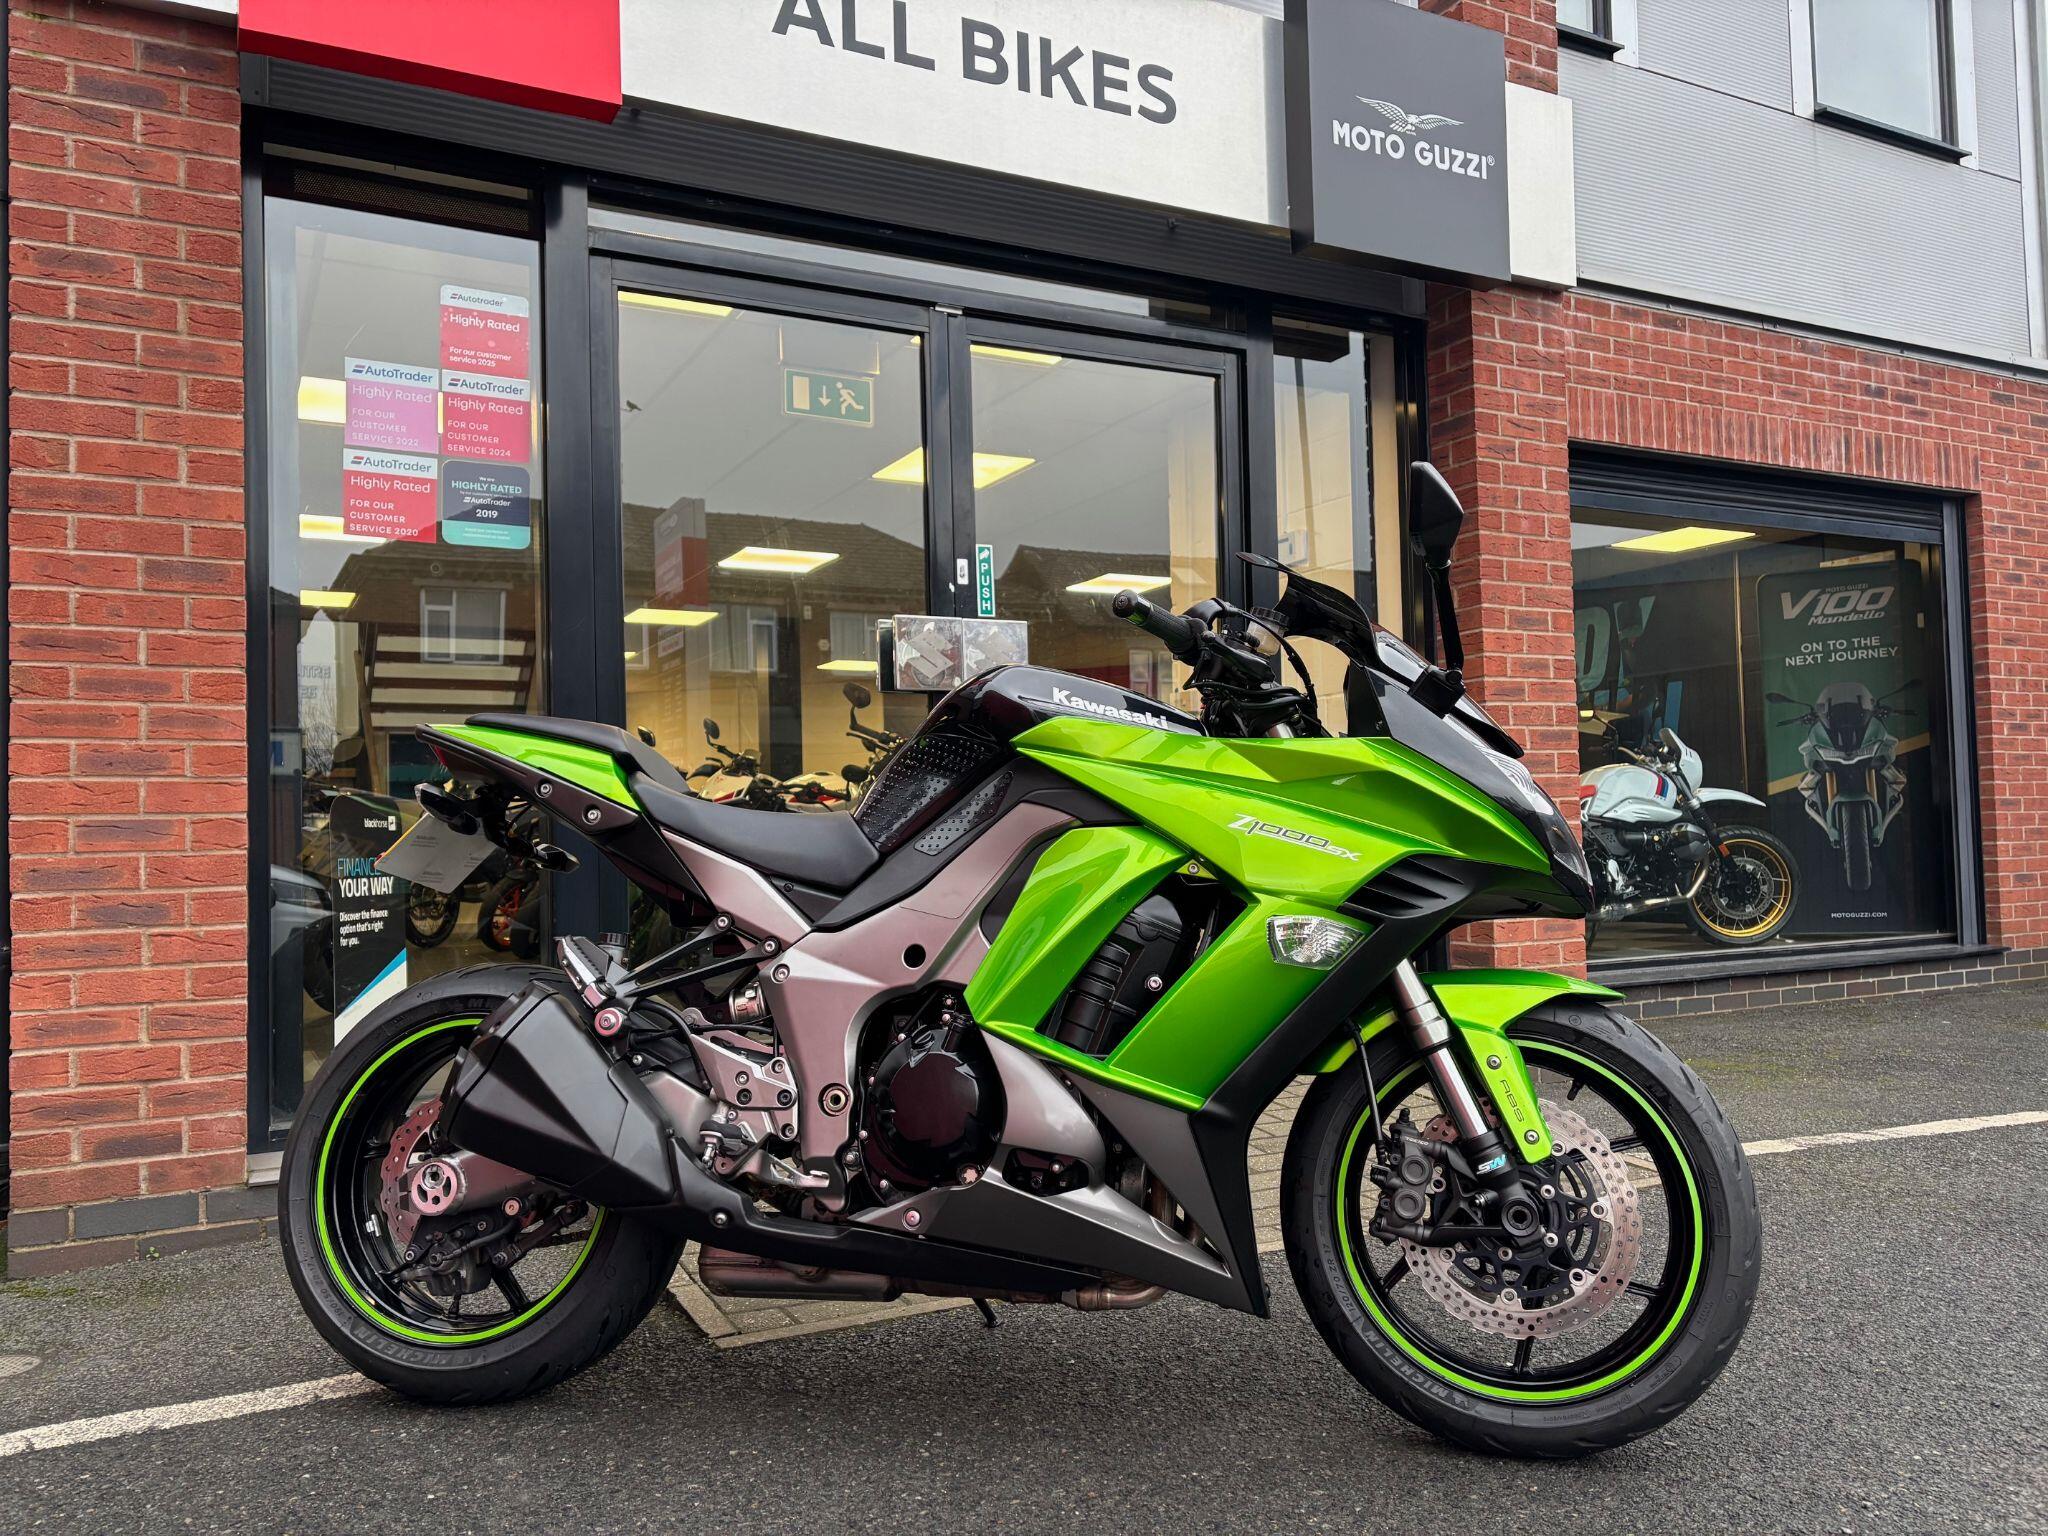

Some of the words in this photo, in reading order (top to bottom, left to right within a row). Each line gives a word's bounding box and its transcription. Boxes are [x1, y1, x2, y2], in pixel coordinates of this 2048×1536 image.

[771, 0, 936, 72] ALL
[961, 16, 1177, 125] BIKES
[1332, 119, 1406, 160] MOTO
[457, 293, 504, 307] Autotrader
[449, 313, 485, 329] Highly
[487, 319, 520, 332] Rated
[449, 346, 462, 354] For
[463, 348, 475, 356] our
[476, 350, 512, 361] customer
[449, 355, 477, 365] service
[364, 366, 433, 383] AutoTrader
[352, 384, 393, 401] Highly
[395, 390, 432, 403] Rated
[460, 379, 525, 395] AutoTrader
[352, 407, 372, 417] FOR
[374, 410, 396, 419] OUR
[448, 397, 486, 413] Highly
[488, 402, 523, 415] Rated
[351, 420, 407, 433] CUSTOMER
[447, 420, 466, 428] FOR
[468, 422, 489, 431] OUR
[351, 432, 393, 443] SERVICE
[447, 432, 499, 444] CUSTOMER
[447, 443, 487, 455] SERVICE
[489, 448, 511, 457] 2024
[363, 456, 432, 473] AutoTrader
[350, 475, 391, 491] Highly
[393, 480, 431, 493] Rated
[451, 480, 489, 491] HIGHLY
[490, 483, 522, 494] RATED
[350, 499, 370, 508] FOR
[372, 501, 395, 510] OUR
[470, 496, 511, 507] AutoTrader
[349, 511, 406, 523] CUSTOMER
[475, 508, 498, 519] 2019
[349, 523, 392, 534] SERVICE
[394, 527, 419, 537] 2020
[980, 563, 991, 611] PUSH
[1825, 584, 1846, 593] MOTO
[1847, 583, 1868, 591] GUZZI
[1780, 586, 1895, 620] V100
[1807, 610, 1886, 626] Mandello
[1800, 642, 1823, 653] ON
[1827, 639, 1847, 650] TO
[1852, 636, 1881, 647] THE
[1785, 653, 1824, 667] NEXT
[1828, 646, 1898, 662] JOURNEY
[1052, 686, 1169, 729] Kawasaki
[339, 877, 369, 898] YOUR
[370, 876, 395, 895] WAY
[339, 910, 361, 922] Discover
[361, 909, 370, 920] the
[370, 908, 388, 919] finance
[1831, 911, 1888, 919] MOTOGUZZI.COM
[340, 924, 356, 936] option
[356, 921, 372, 932] that's
[372, 920, 384, 933] right
[340, 936, 348, 947] for
[348, 936, 360, 948] you.
[1500, 1079, 1525, 1123] ABS
[1332, 1276, 1356, 1314] 120/70
[353, 1326, 450, 1365] MICHELIN
[1363, 1328, 1450, 1399] MICHELIN
